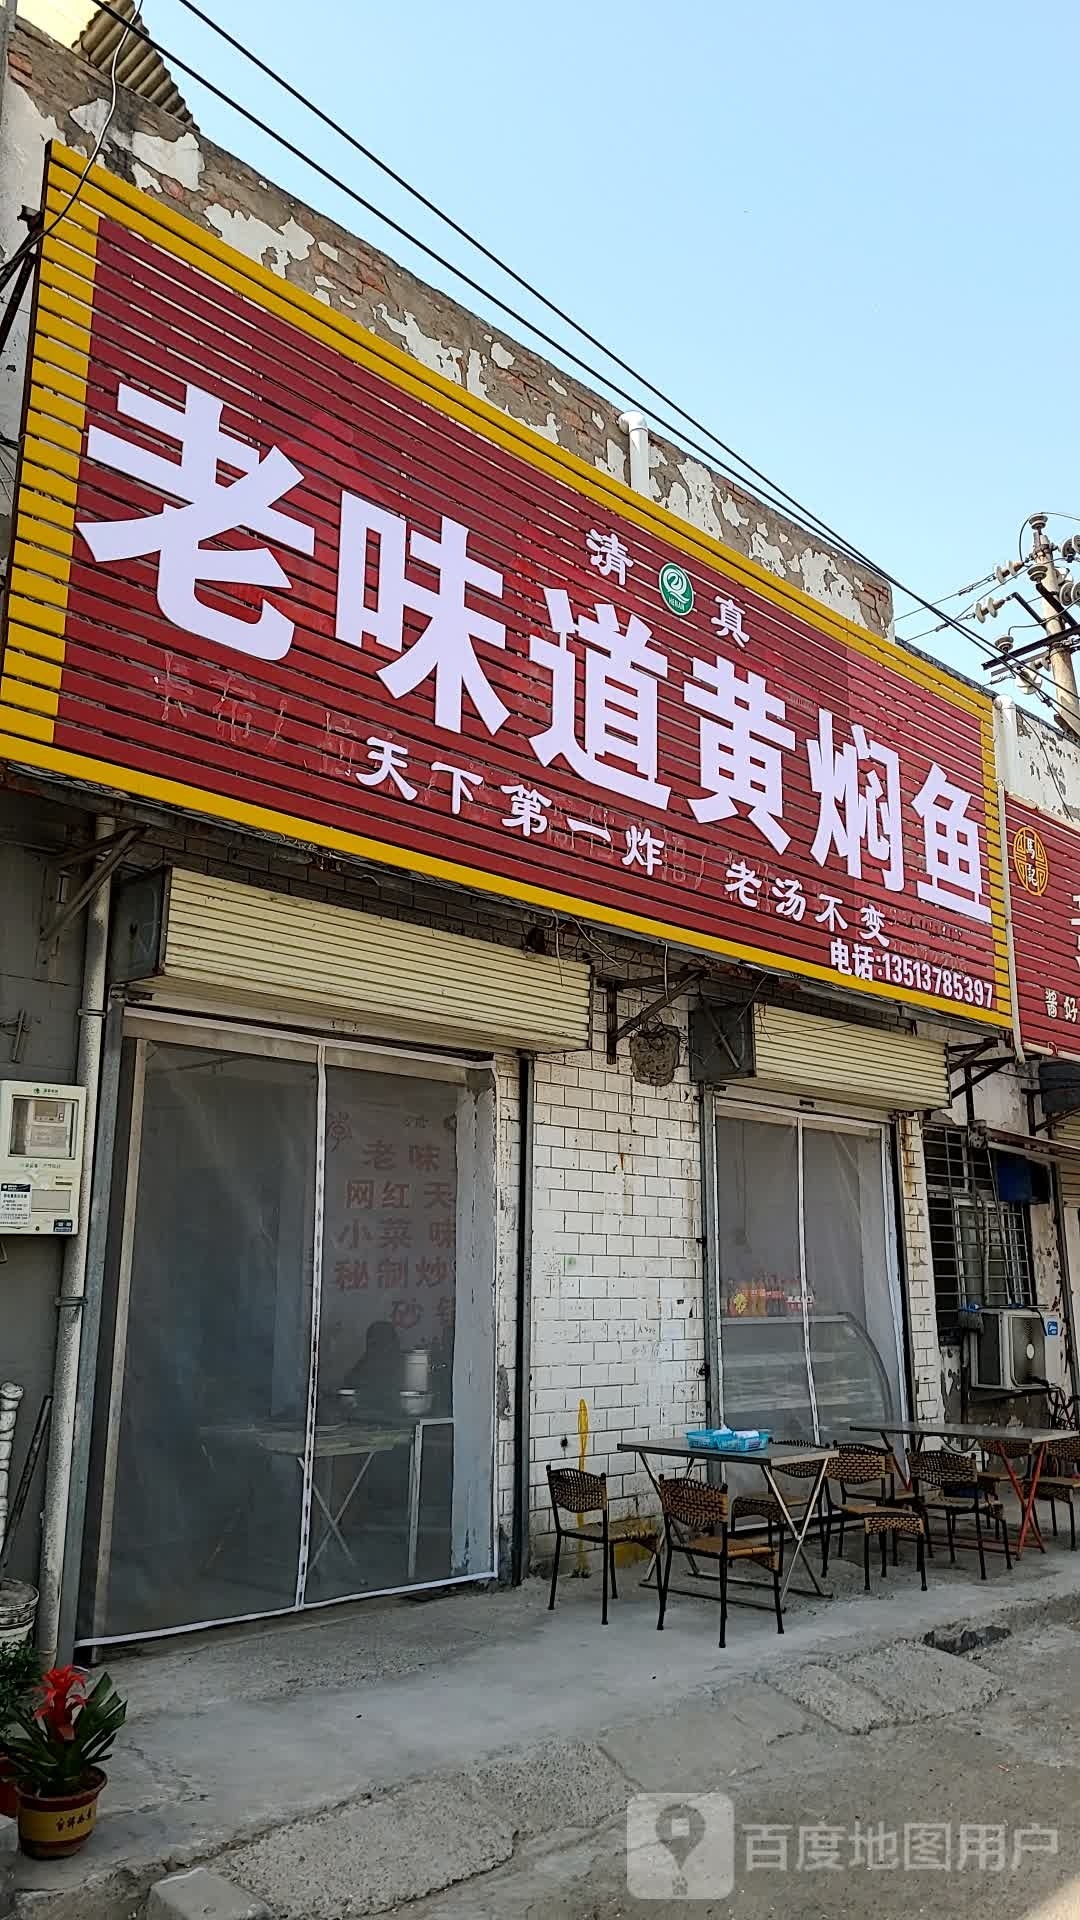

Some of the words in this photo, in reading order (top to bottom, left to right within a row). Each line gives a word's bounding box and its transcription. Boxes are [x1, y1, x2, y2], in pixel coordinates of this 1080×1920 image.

[74, 381, 993, 925] 老味道黄焖鱼
[355, 736, 666, 876] 天下第一炸
[724, 860, 890, 948] 老汤不变
